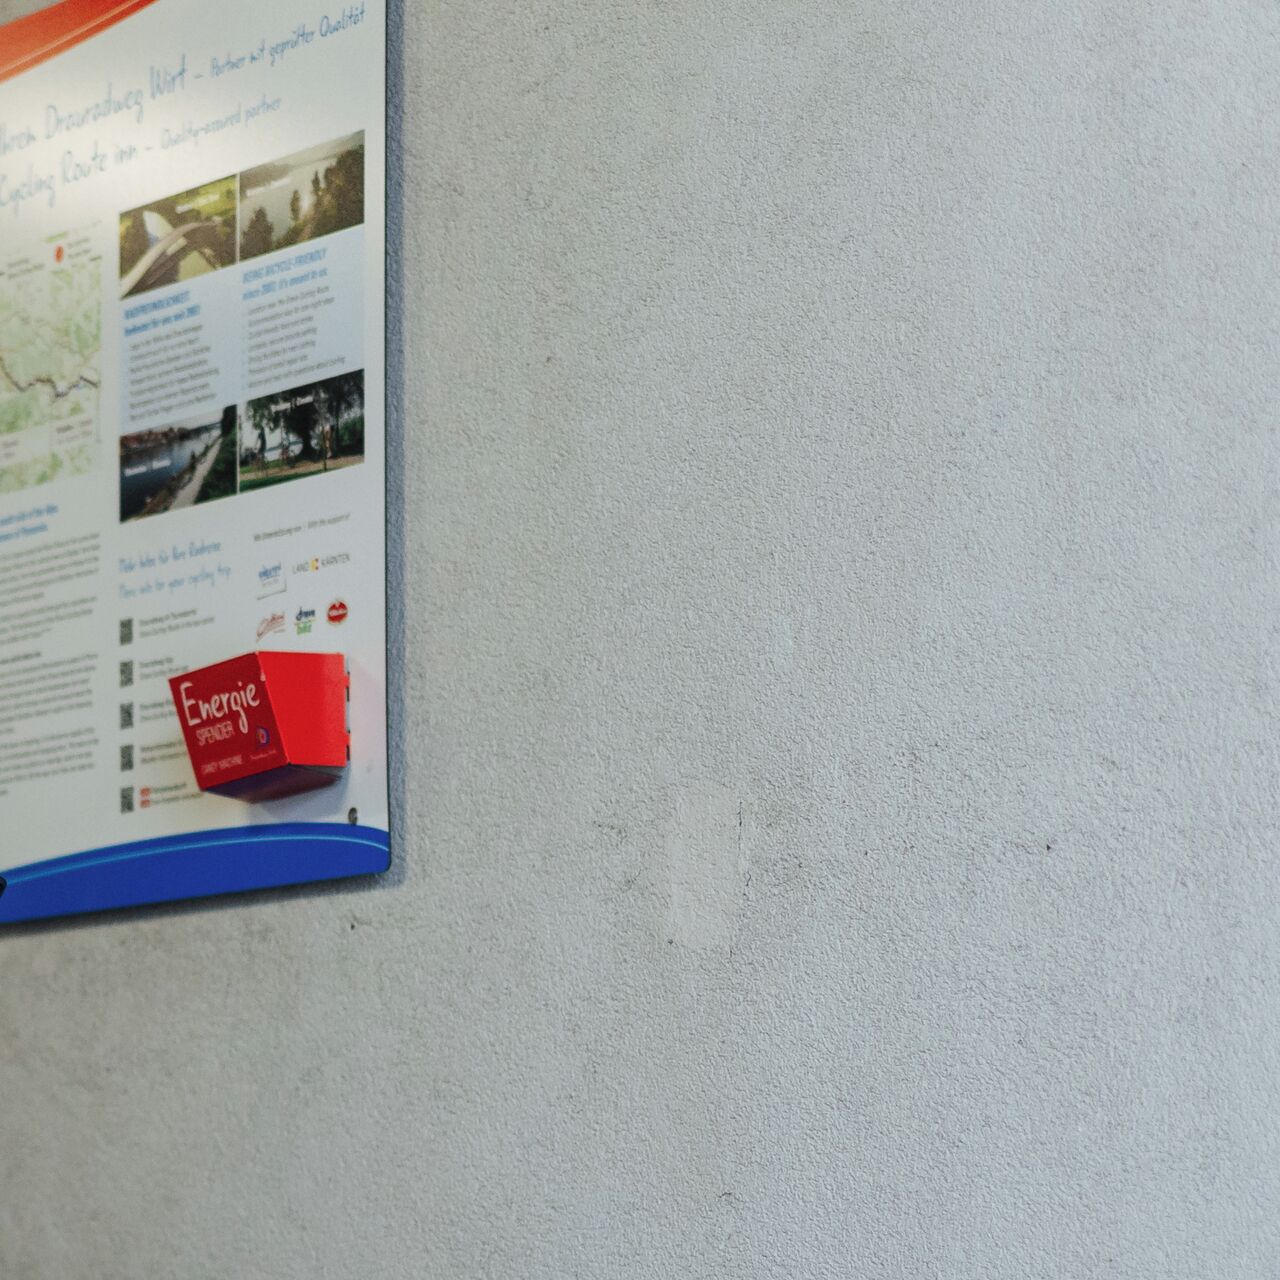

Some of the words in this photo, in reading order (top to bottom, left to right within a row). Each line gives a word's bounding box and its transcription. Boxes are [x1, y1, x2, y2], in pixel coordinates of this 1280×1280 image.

[45, 82, 144, 141] Drauradweg
[149, 53, 187, 100] Wirt
[319, 2, 366, 38] Qualität
[61, 140, 109, 185] Route
[180, 680, 260, 733] Energie
[195, 721, 234, 746] SPENDER
